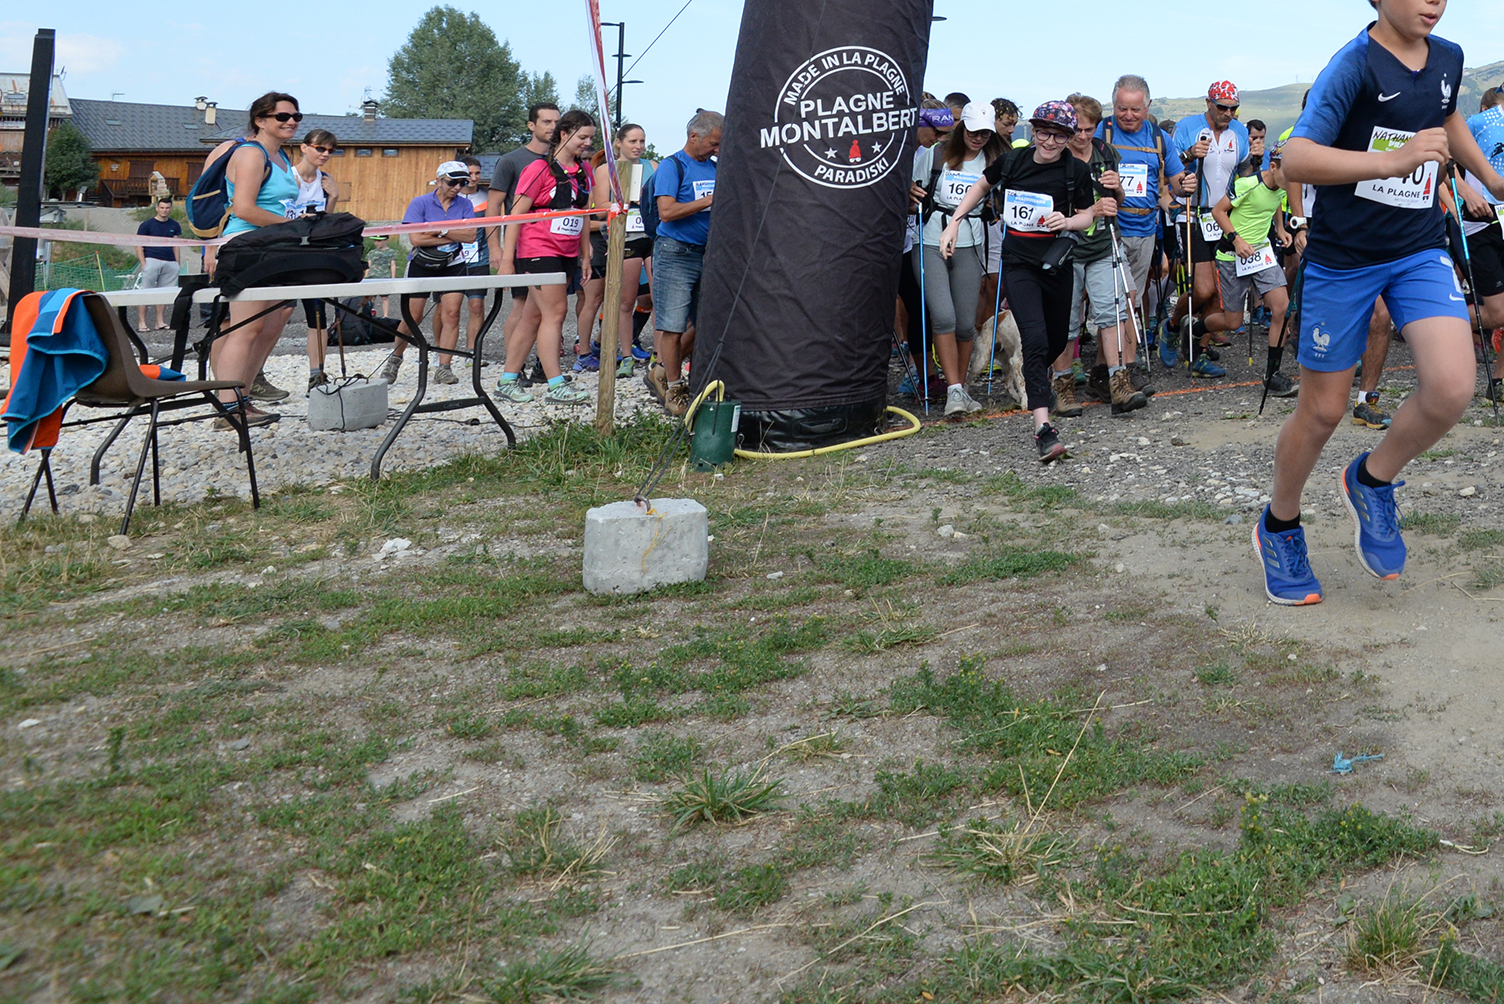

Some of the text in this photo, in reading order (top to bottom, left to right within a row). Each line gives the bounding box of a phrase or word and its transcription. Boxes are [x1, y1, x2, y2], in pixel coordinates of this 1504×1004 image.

[783, 51, 906, 106] MADE IN LA PLAGNE
[800, 91, 895, 118] PLAGNE
[760, 107, 918, 148] MONTALBERT
[813, 156, 890, 183] PARADISKI
[1372, 184, 1421, 199] LA PLAGNE
[562, 217, 580, 228] 019
[1011, 206, 1034, 221] 161
[1206, 222, 1220, 232] 06
